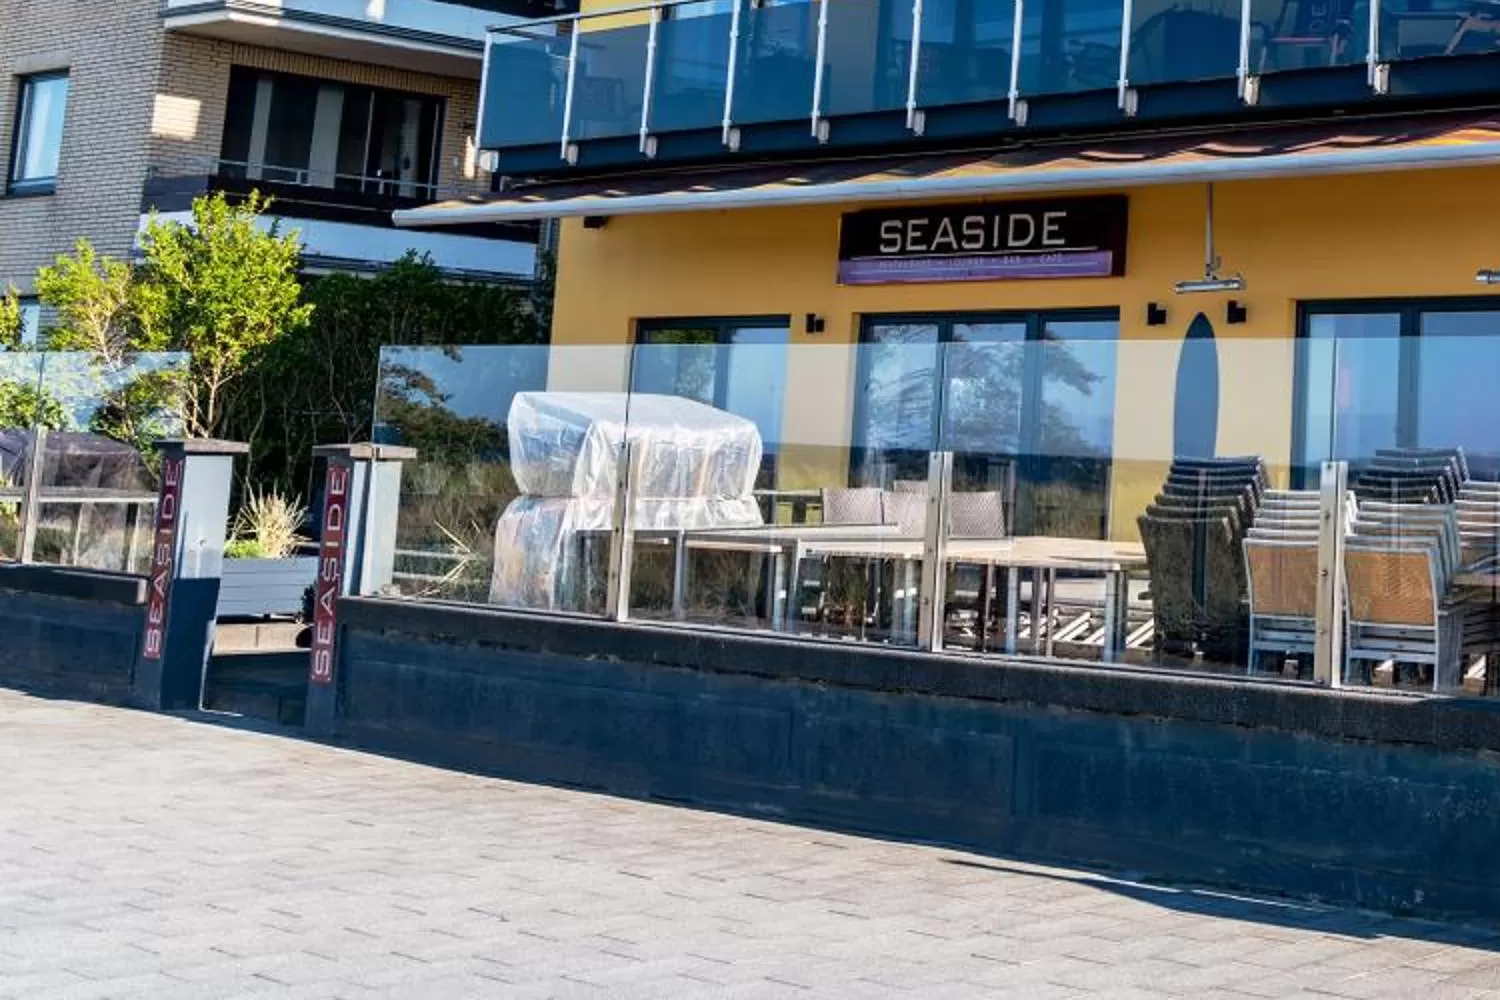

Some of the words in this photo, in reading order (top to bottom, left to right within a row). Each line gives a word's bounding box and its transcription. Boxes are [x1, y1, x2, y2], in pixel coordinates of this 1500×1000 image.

[880, 211, 1067, 253] SEASIDE
[147, 460, 181, 653] SEASIDE
[314, 469, 348, 675] SEASIDE
